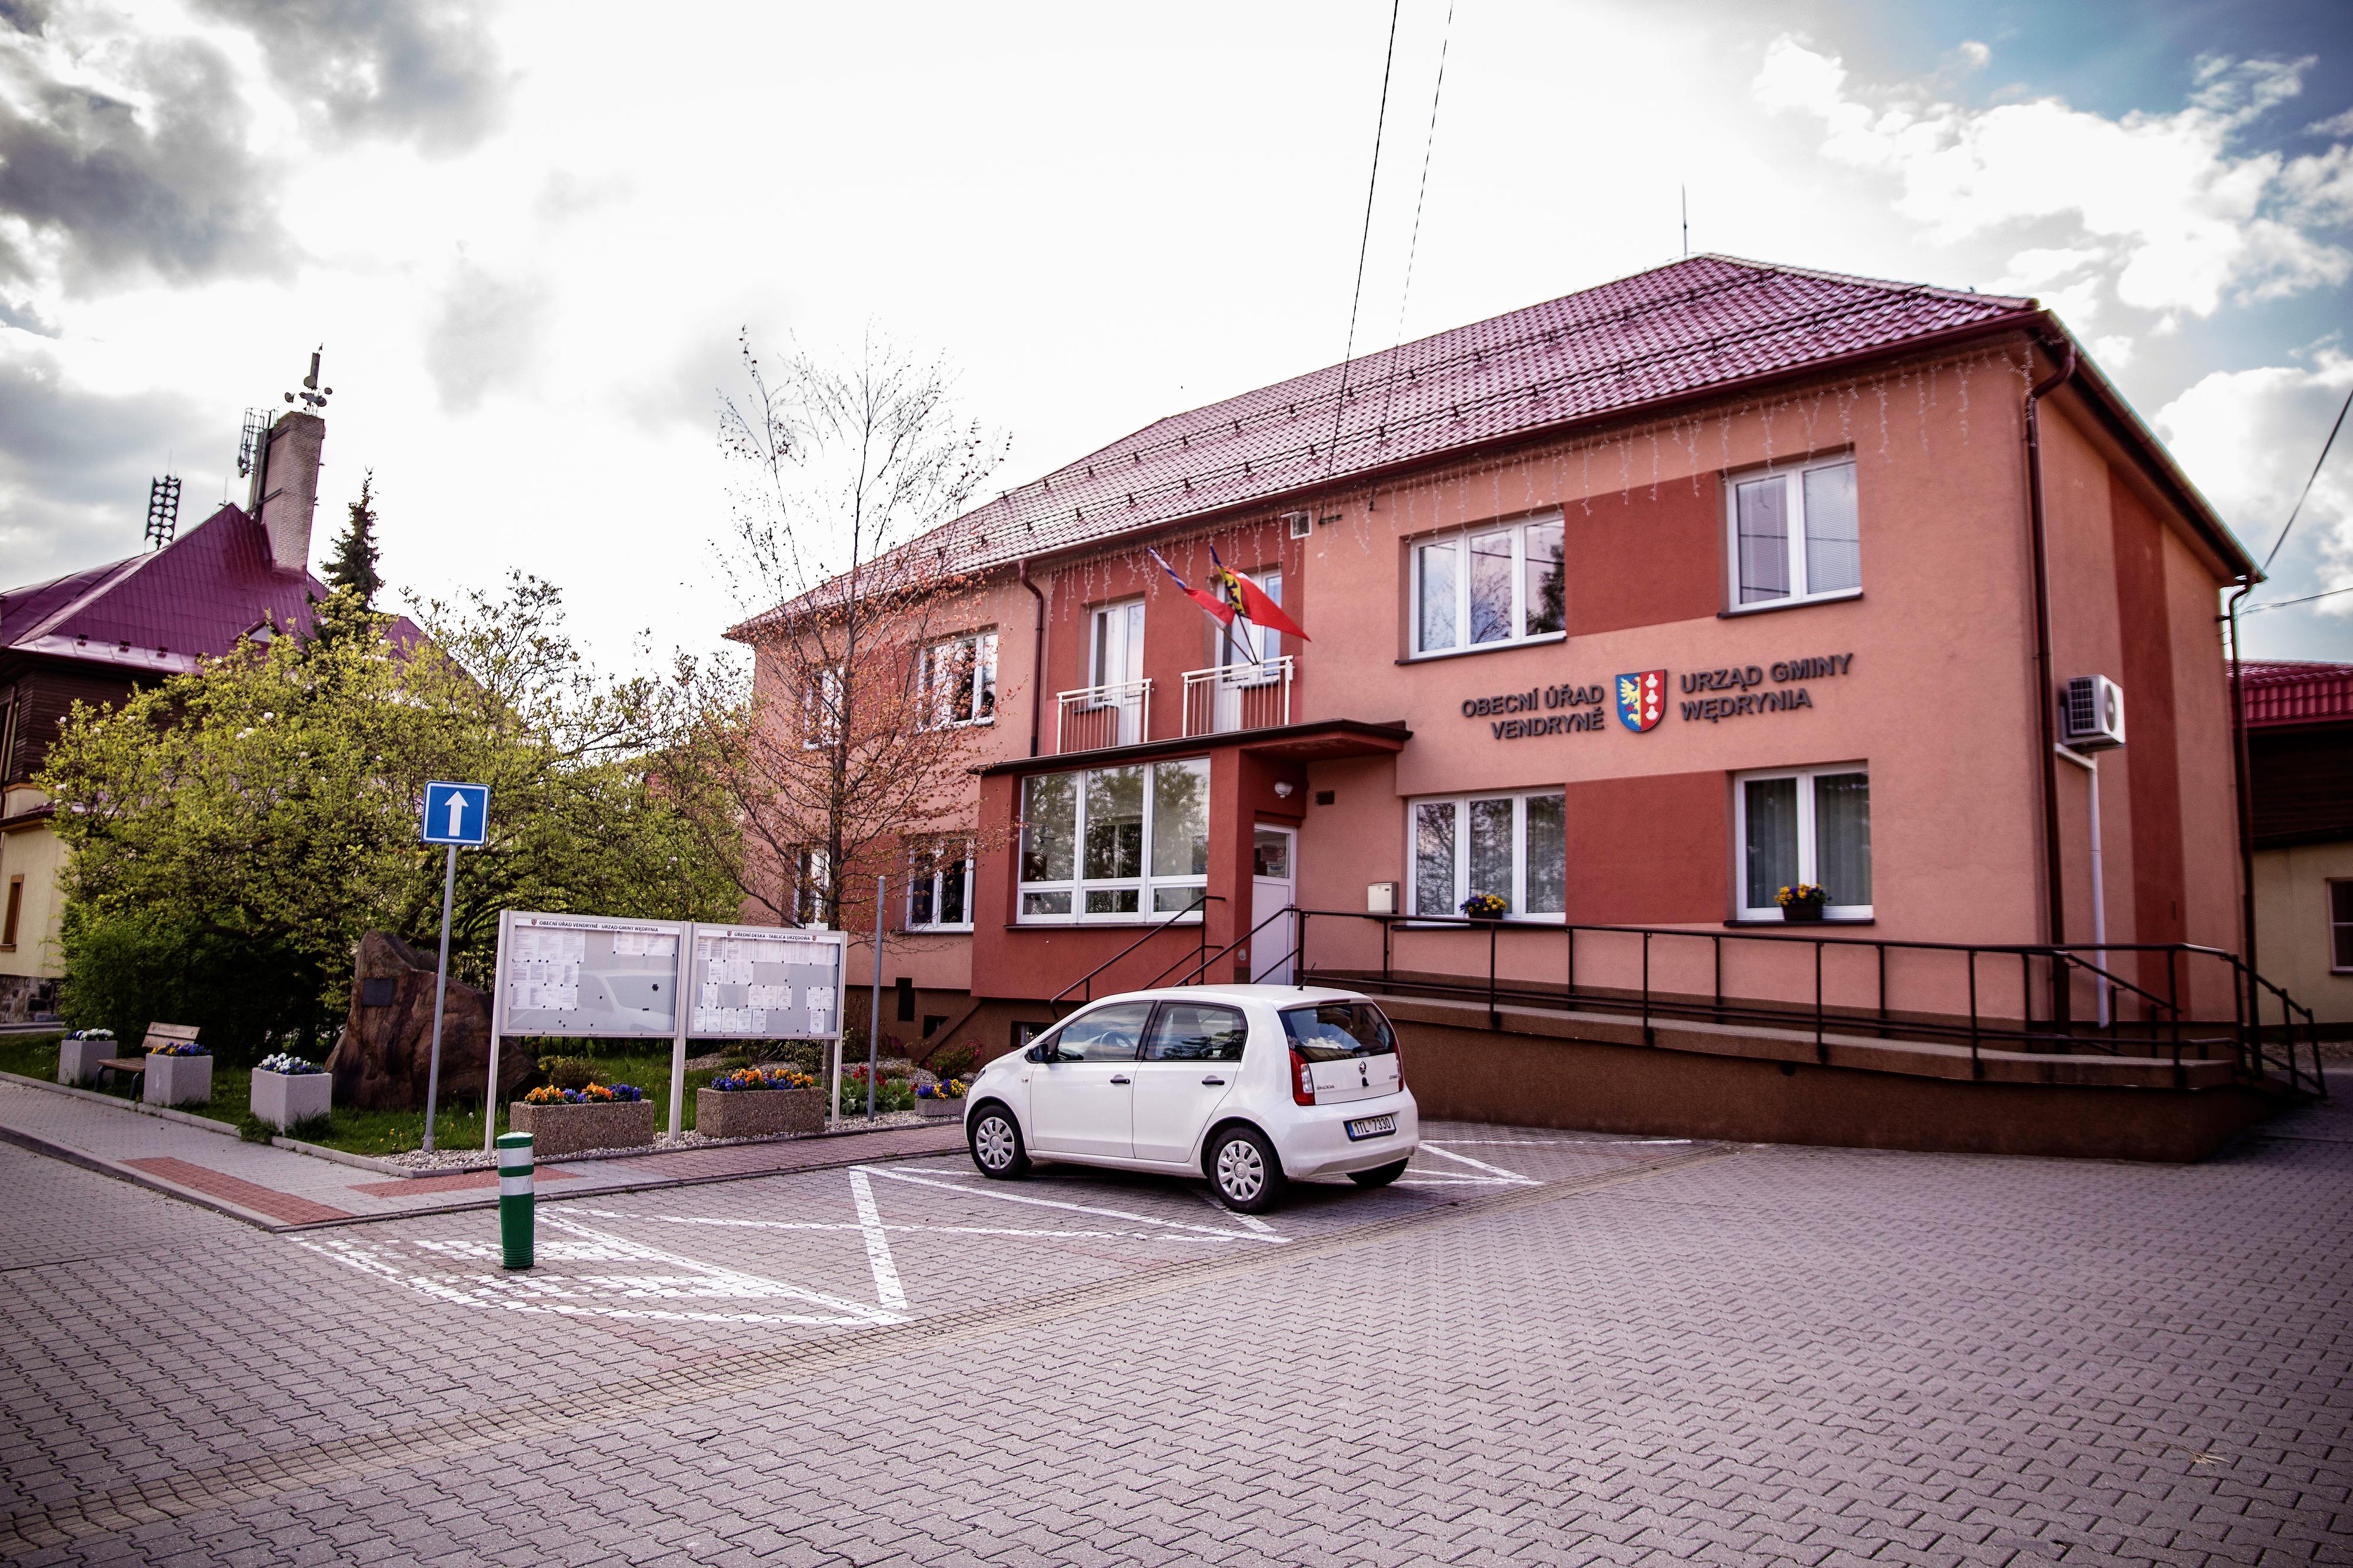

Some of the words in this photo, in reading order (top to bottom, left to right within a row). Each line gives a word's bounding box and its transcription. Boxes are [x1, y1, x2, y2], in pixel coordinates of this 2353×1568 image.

[1680, 665, 1763, 693] URZĄD
[1769, 652, 1854, 682] GMINY
[1461, 687, 1539, 718] OBECNÍ
[1544, 684, 1605, 708] ÚŘAD
[1680, 688, 1812, 723] WĘDRYNIA
[1490, 706, 1605, 739] VENDRYNĚ
[1354, 1120, 1369, 1134] 1TL
[1372, 1117, 1391, 1131] 7330
